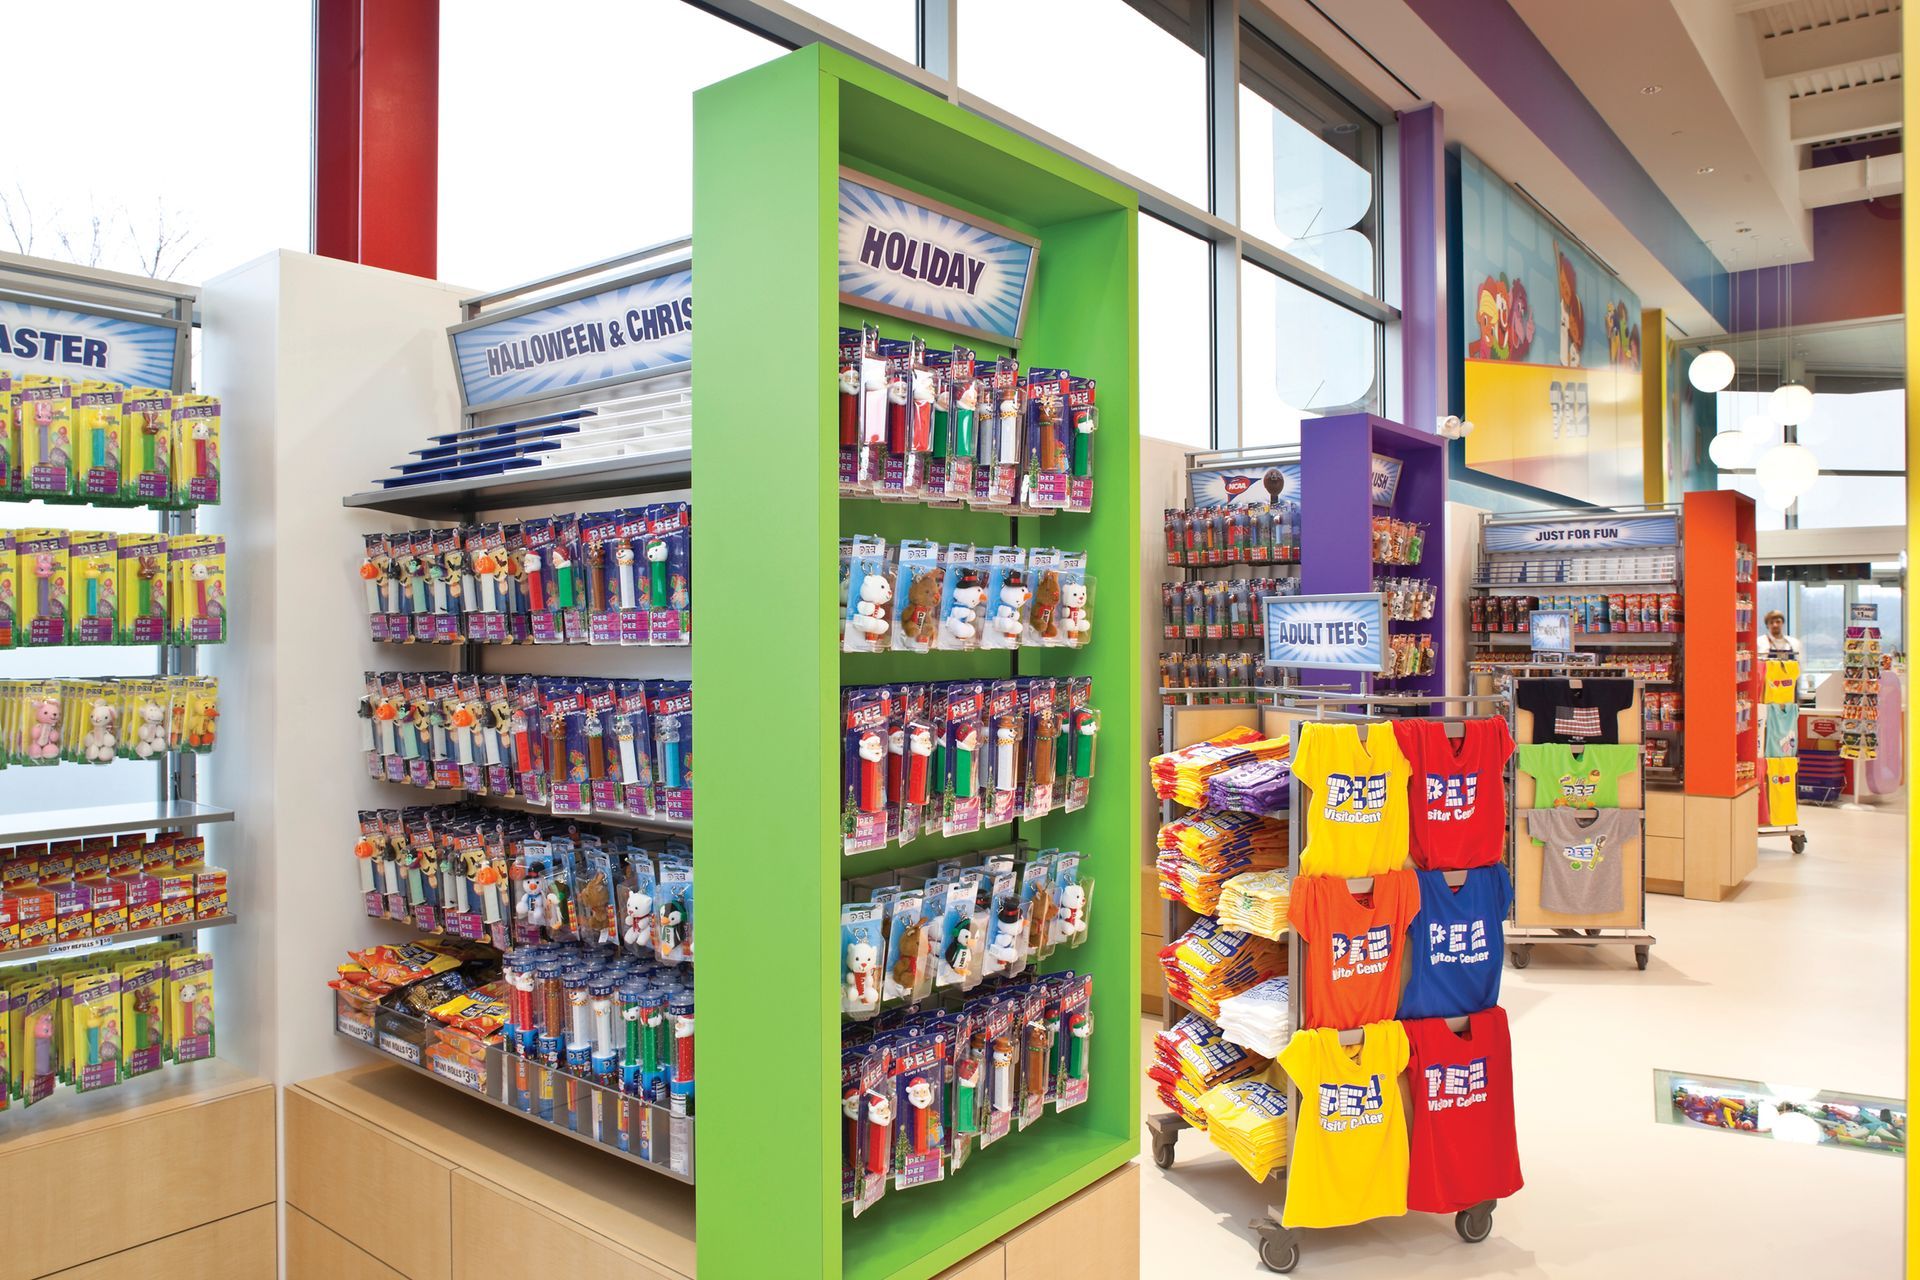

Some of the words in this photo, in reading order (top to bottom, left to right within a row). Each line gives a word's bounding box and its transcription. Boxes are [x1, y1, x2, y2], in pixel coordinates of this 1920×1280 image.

[860, 225, 986, 295] HOLIDAY
[487, 322, 606, 376] HALLOWEEN
[609, 320, 626, 348] &
[31, 388, 61, 400] PEZ
[87, 393, 113, 405] PEZ
[136, 399, 165, 411] PEZ
[188, 405, 212, 417] PEZ
[1228, 482, 1248, 491] NCAA
[1536, 531, 1564, 541] JUST
[1567, 529, 1590, 540] FOR
[1594, 528, 1618, 539] FUN
[29, 540, 58, 551] PEZ
[78, 543, 107, 554] PEZ
[134, 545, 161, 556] PEZ
[188, 545, 216, 557] PEZ
[1279, 622, 1322, 645] ADULT
[1328, 622, 1368, 646] TEE'S
[1327, 773, 1387, 810] PEZ
[1563, 784, 1596, 796] PEZ
[1565, 847, 1594, 858] PEZ
[167, 902, 189, 914] PEZ
[200, 898, 221, 910] PEZ
[98, 911, 121, 923] PEZ
[133, 906, 155, 918] PEZ
[62, 917, 84, 929] PEZ
[25, 923, 48, 936] PEZ
[1429, 920, 1487, 952] PEZ
[50, 945, 70, 953] CANDY
[1425, 1057, 1488, 1098] PEZ
